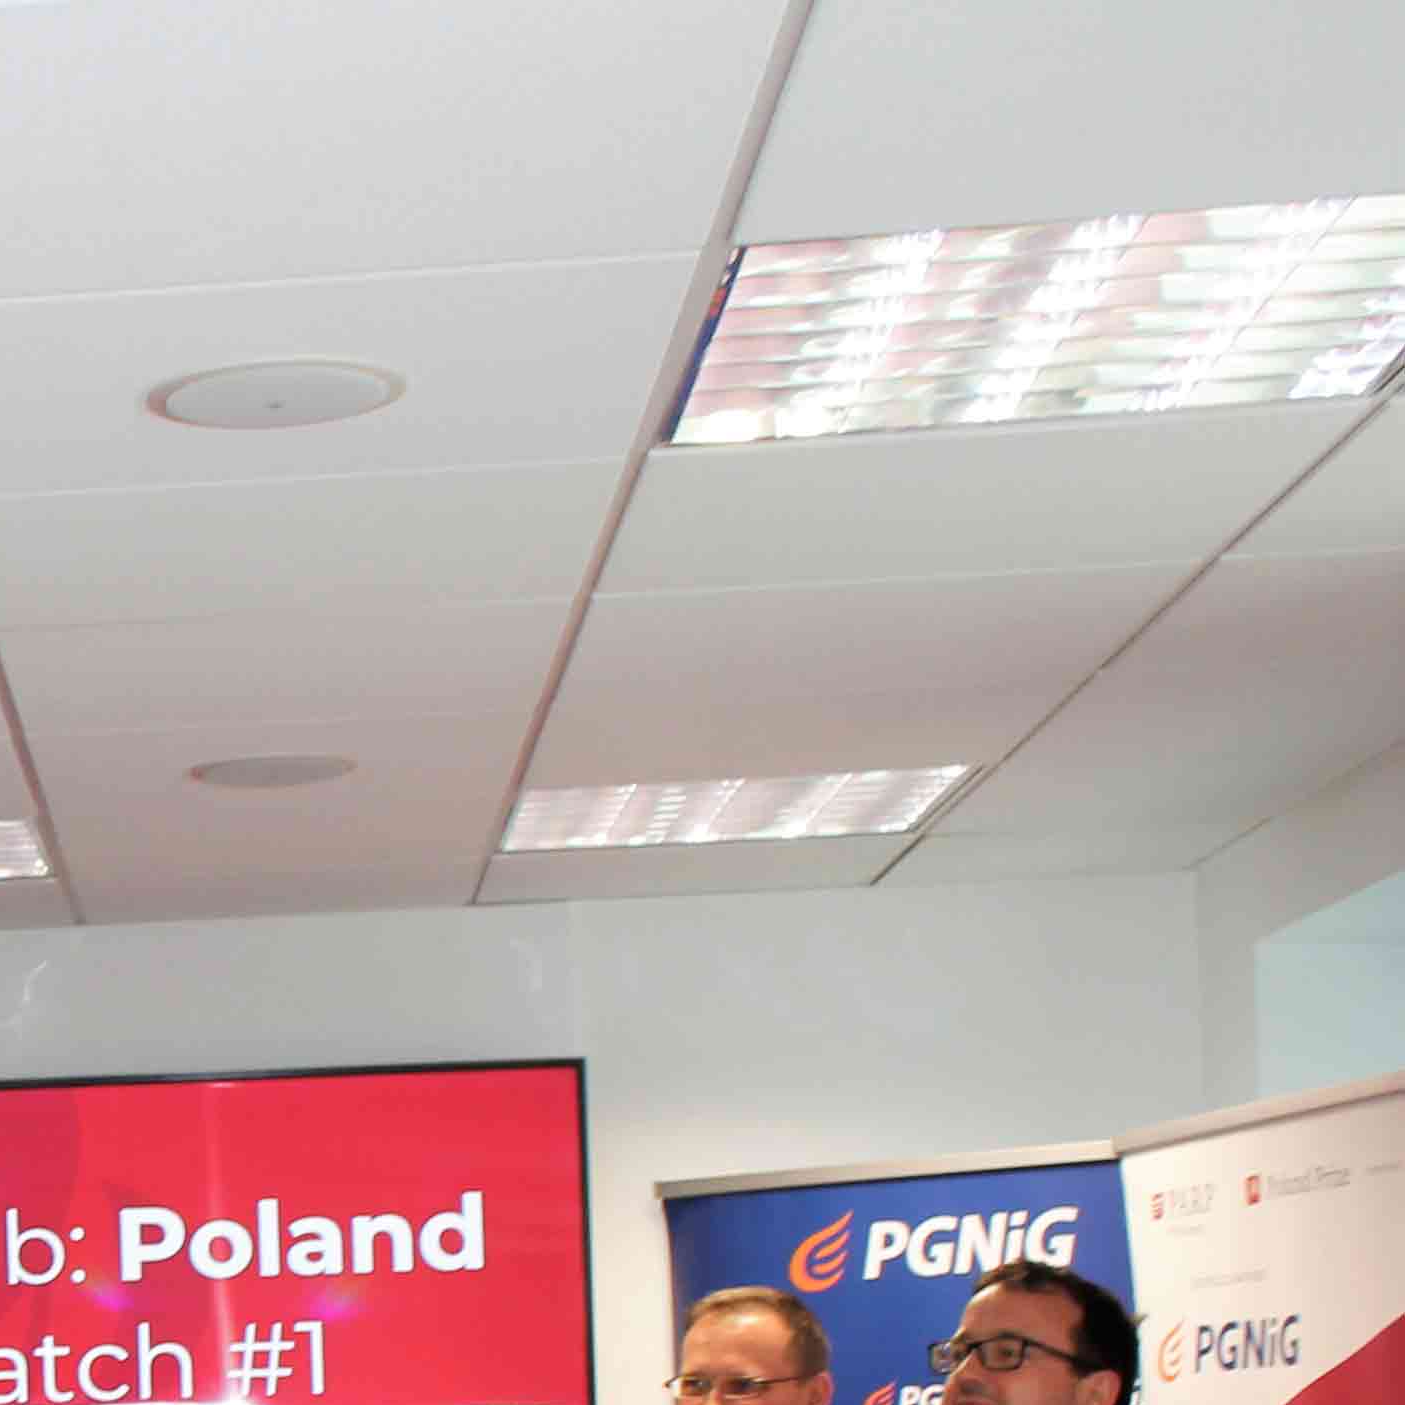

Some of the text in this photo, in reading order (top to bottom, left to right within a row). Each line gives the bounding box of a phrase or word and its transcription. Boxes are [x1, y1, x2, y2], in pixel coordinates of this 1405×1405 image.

[118, 1191, 485, 1280] Poland
[862, 1206, 1079, 1281] PGNiG
[228, 1321, 329, 1397] #1
[1195, 1313, 1301, 1374] PGNiG
